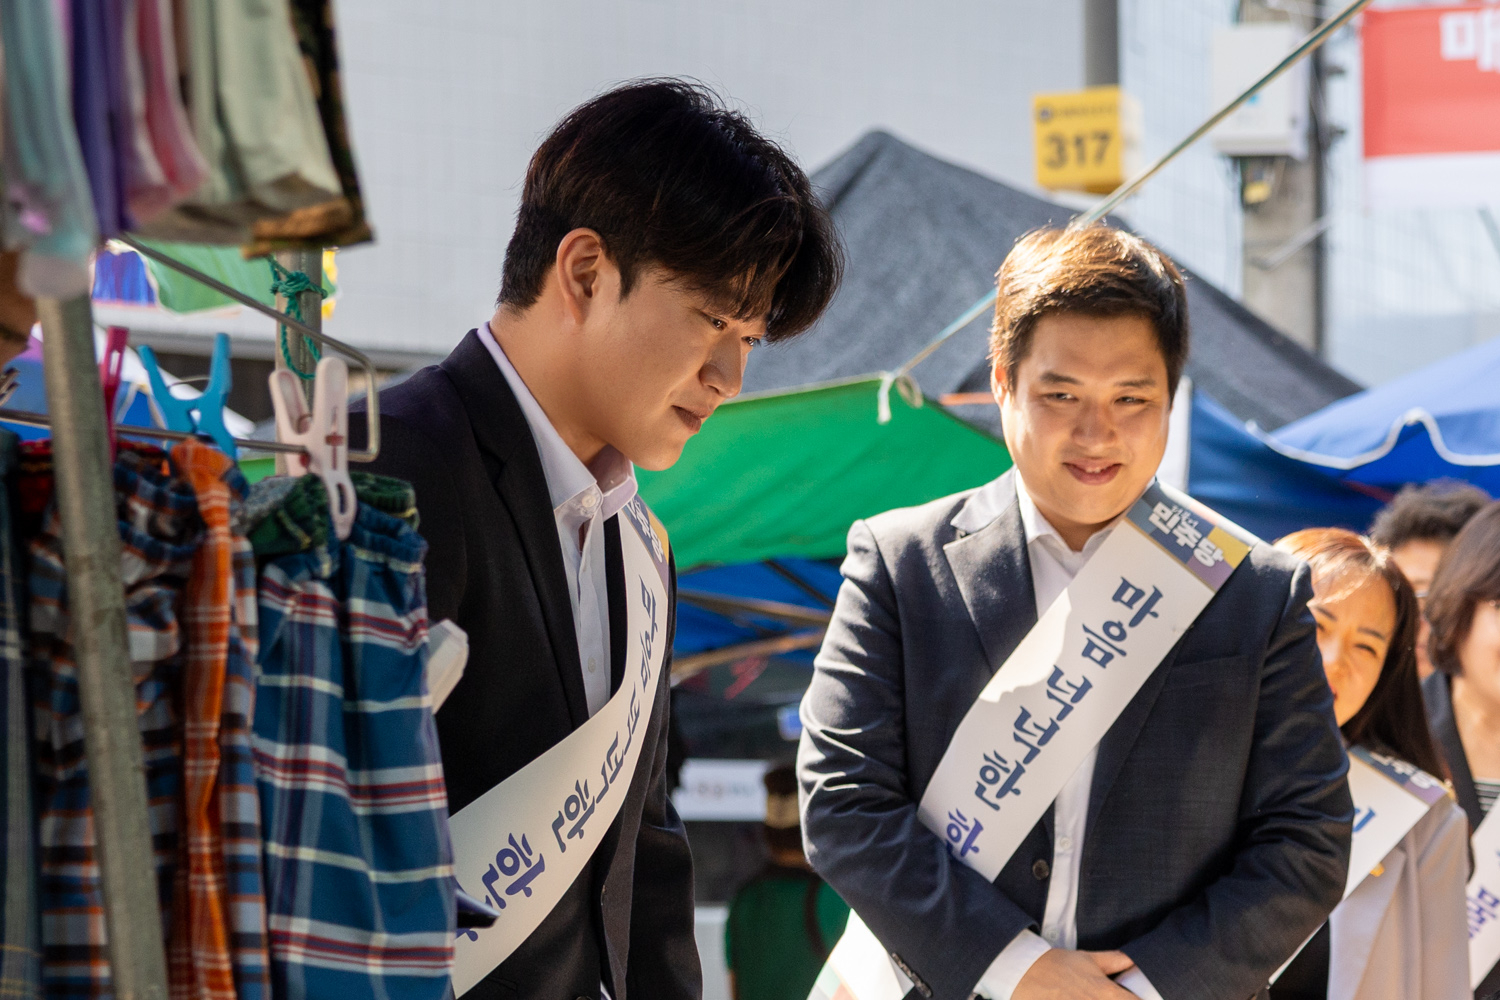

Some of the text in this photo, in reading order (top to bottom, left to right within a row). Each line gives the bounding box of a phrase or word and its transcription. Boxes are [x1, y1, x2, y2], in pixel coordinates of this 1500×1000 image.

[1044, 131, 1112, 170] 317
[1148, 501, 1225, 568] 민주당
[637, 573, 659, 692] 마음
[1081, 576, 1164, 669] 마음
[551, 682, 641, 854] 넉넉한
[975, 665, 1093, 811] 넉넉한
